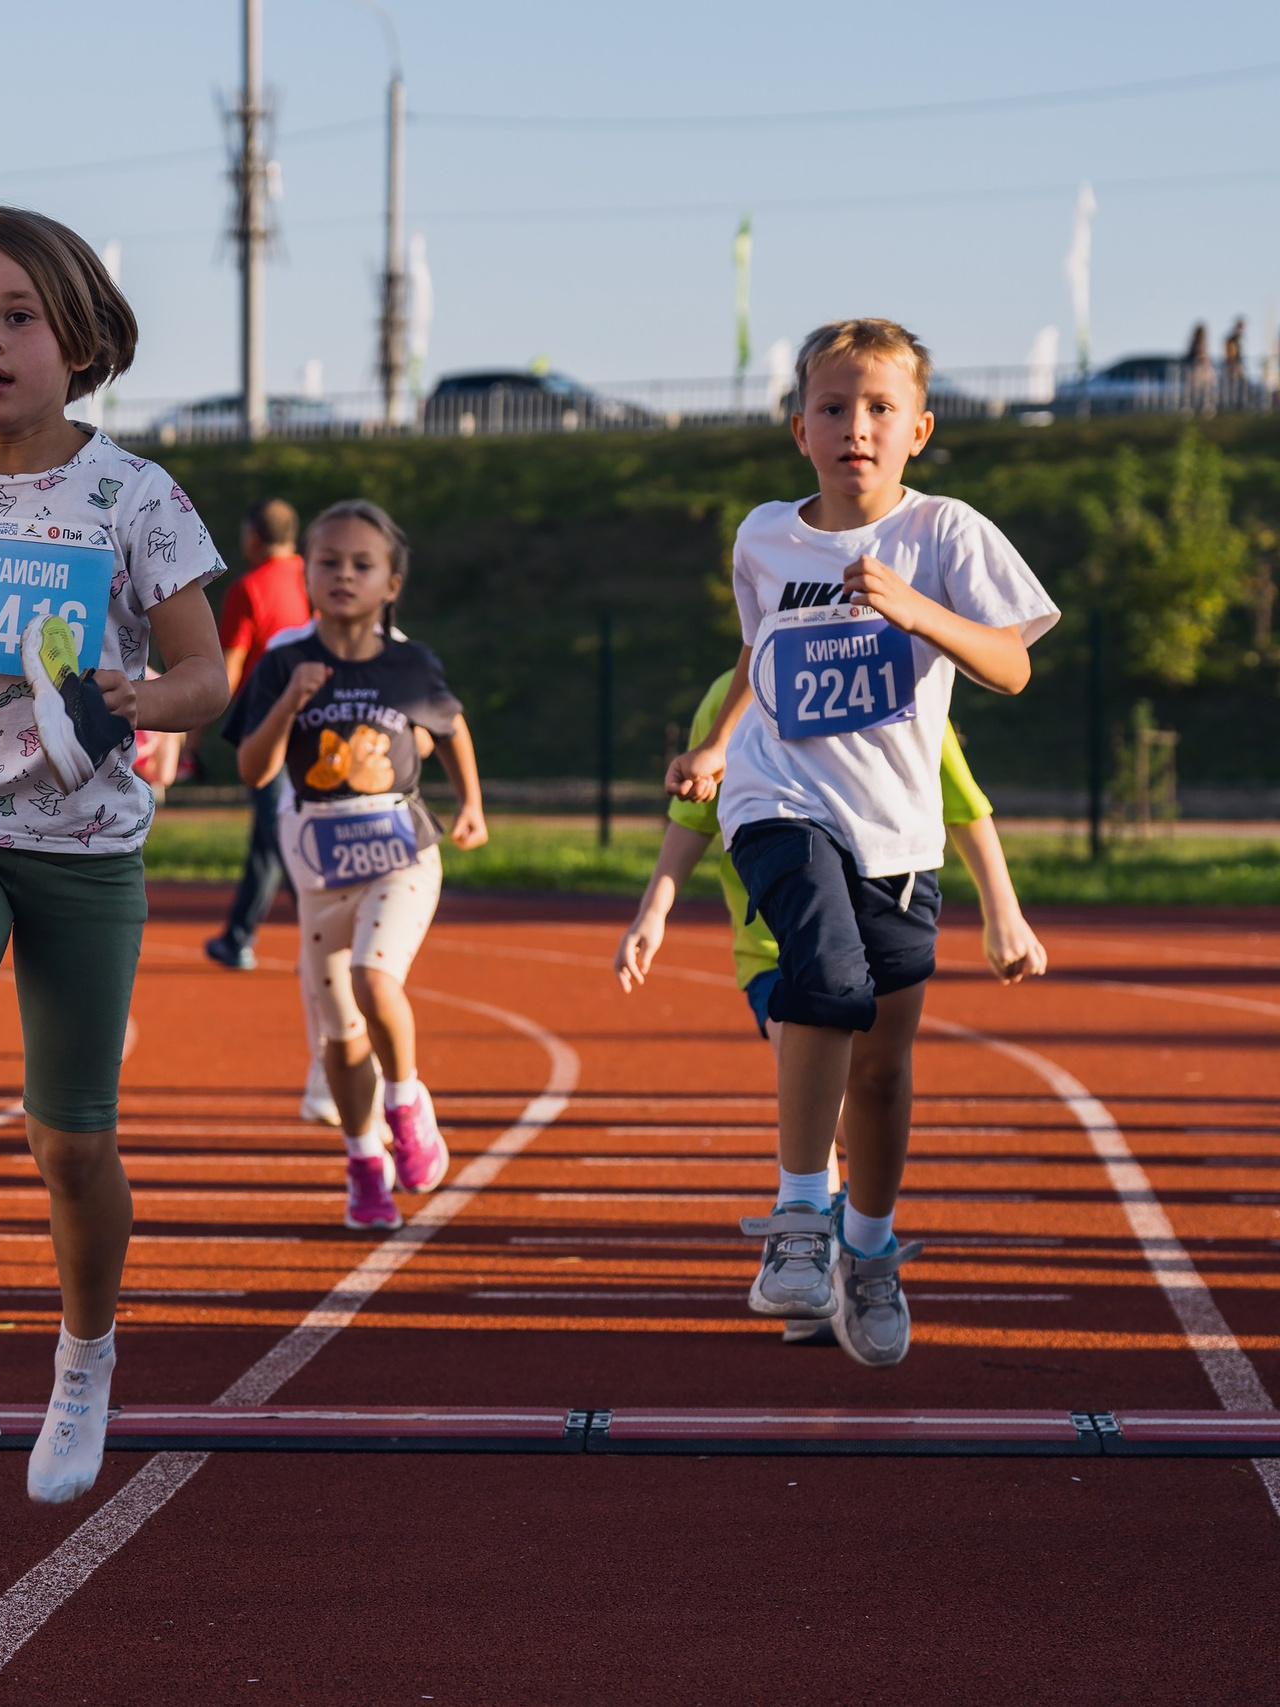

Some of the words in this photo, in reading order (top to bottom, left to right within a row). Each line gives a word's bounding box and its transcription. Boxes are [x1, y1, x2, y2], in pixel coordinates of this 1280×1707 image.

[62, 528, 82, 541] Пэй
[805, 633, 879, 662] КИРИЛЛ
[795, 661, 897, 721] 2241
[296, 702, 408, 734] TOGETHER
[332, 837, 410, 879] 2890
